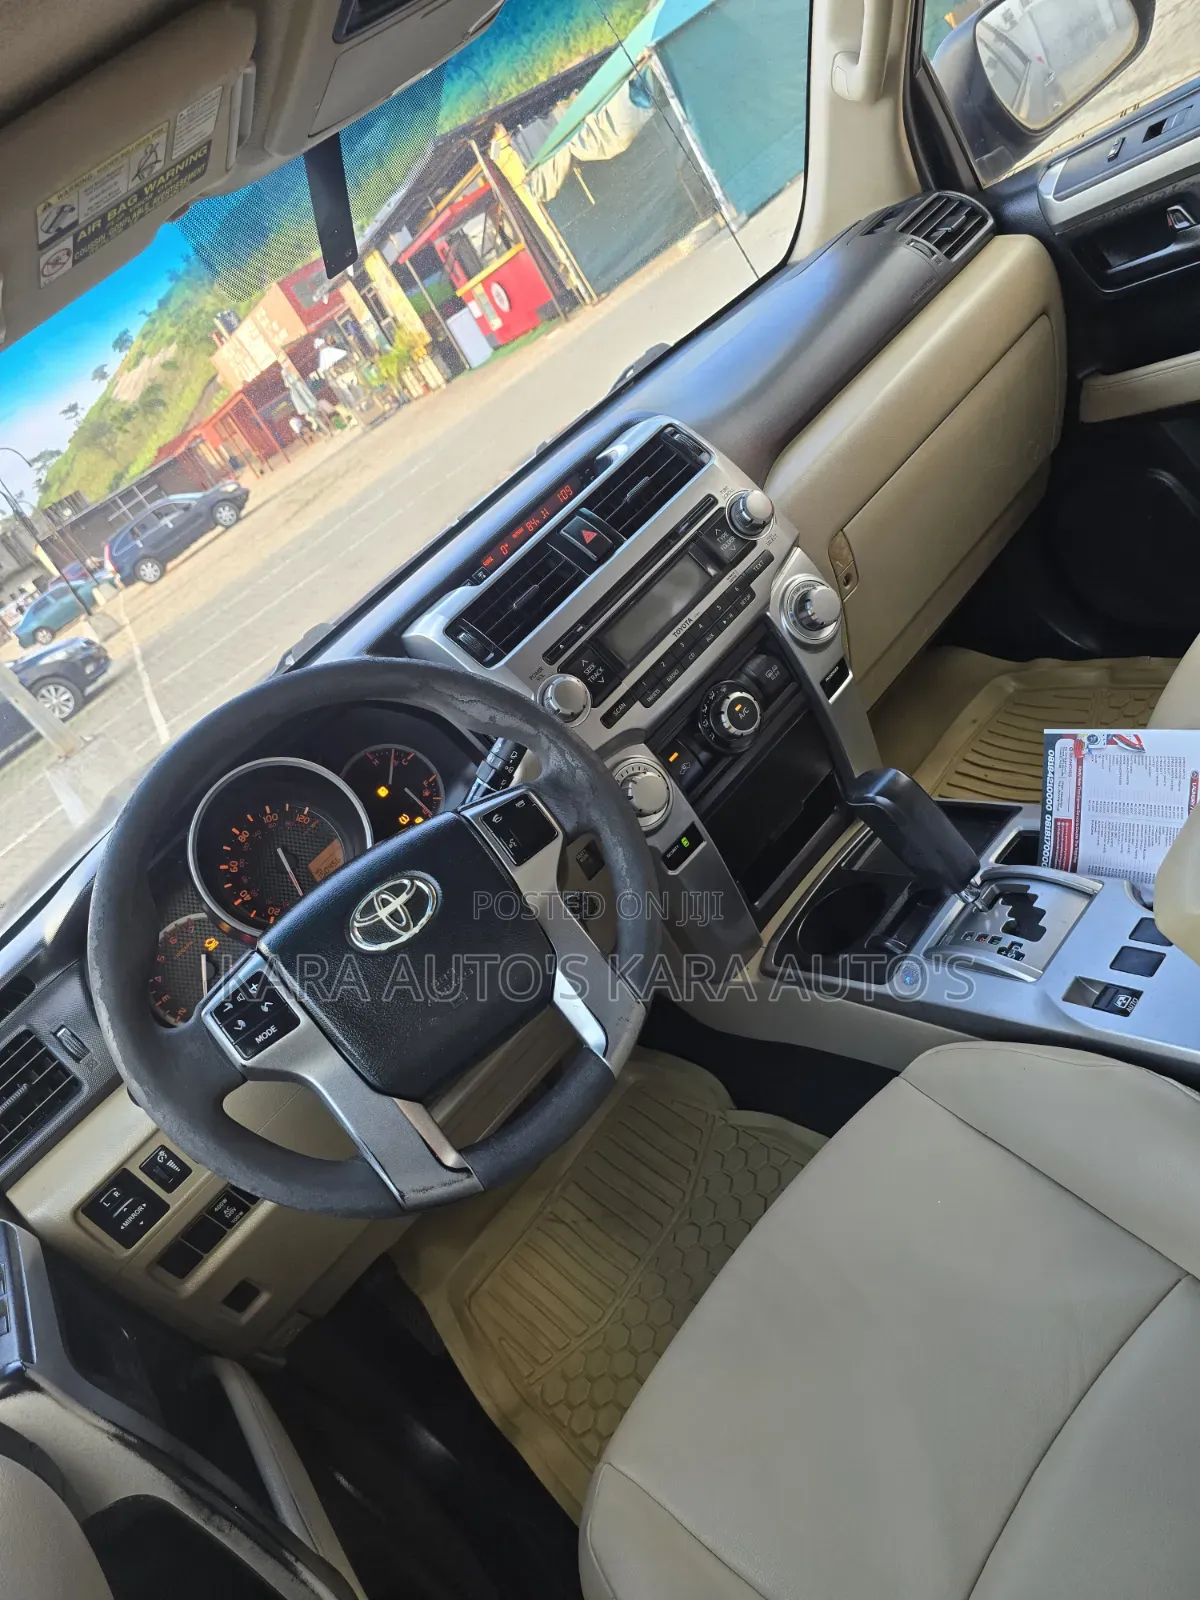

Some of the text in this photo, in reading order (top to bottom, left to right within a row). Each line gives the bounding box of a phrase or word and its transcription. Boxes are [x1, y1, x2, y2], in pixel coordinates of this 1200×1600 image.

[57, 174, 93, 201] WARNING
[77, 219, 101, 242] AIR
[107, 194, 138, 221] BAG
[144, 145, 208, 195] WARNING
[75, 233, 106, 260] COUSSIN
[717, 532, 730, 544] TYPE
[720, 536, 737, 552] FOLDER
[752, 560, 764, 572] TEXT
[672, 617, 694, 638] TOYOTA
[705, 633, 715, 642] AUX
[688, 652, 696, 660] CD
[529, 666, 545, 680] POWER
[583, 662, 597, 676] SEEK
[588, 667, 605, 683] TRACK
[666, 669, 680, 682] RADIO
[613, 702, 627, 716] SCAN
[738, 708, 750, 720] A/C
[372, 759, 380, 767] H
[1045, 749, 1055, 812] 08184210000
[1189, 782, 1197, 807] LAUNDRY
[263, 813, 279, 824] 100
[296, 814, 310, 824] 120
[238, 830, 250, 843] 80
[666, 844, 680, 859] SECURITY
[229, 860, 239, 873] 60
[239, 889, 252, 901] 40
[267, 906, 281, 916] 20
[1126, 997, 1139, 1013] AUTO
[254, 1024, 278, 1045] MODE
[214, 1198, 228, 1212] 400W
[223, 1205, 231, 1214] AC
[122, 1205, 145, 1228] MIRROR
